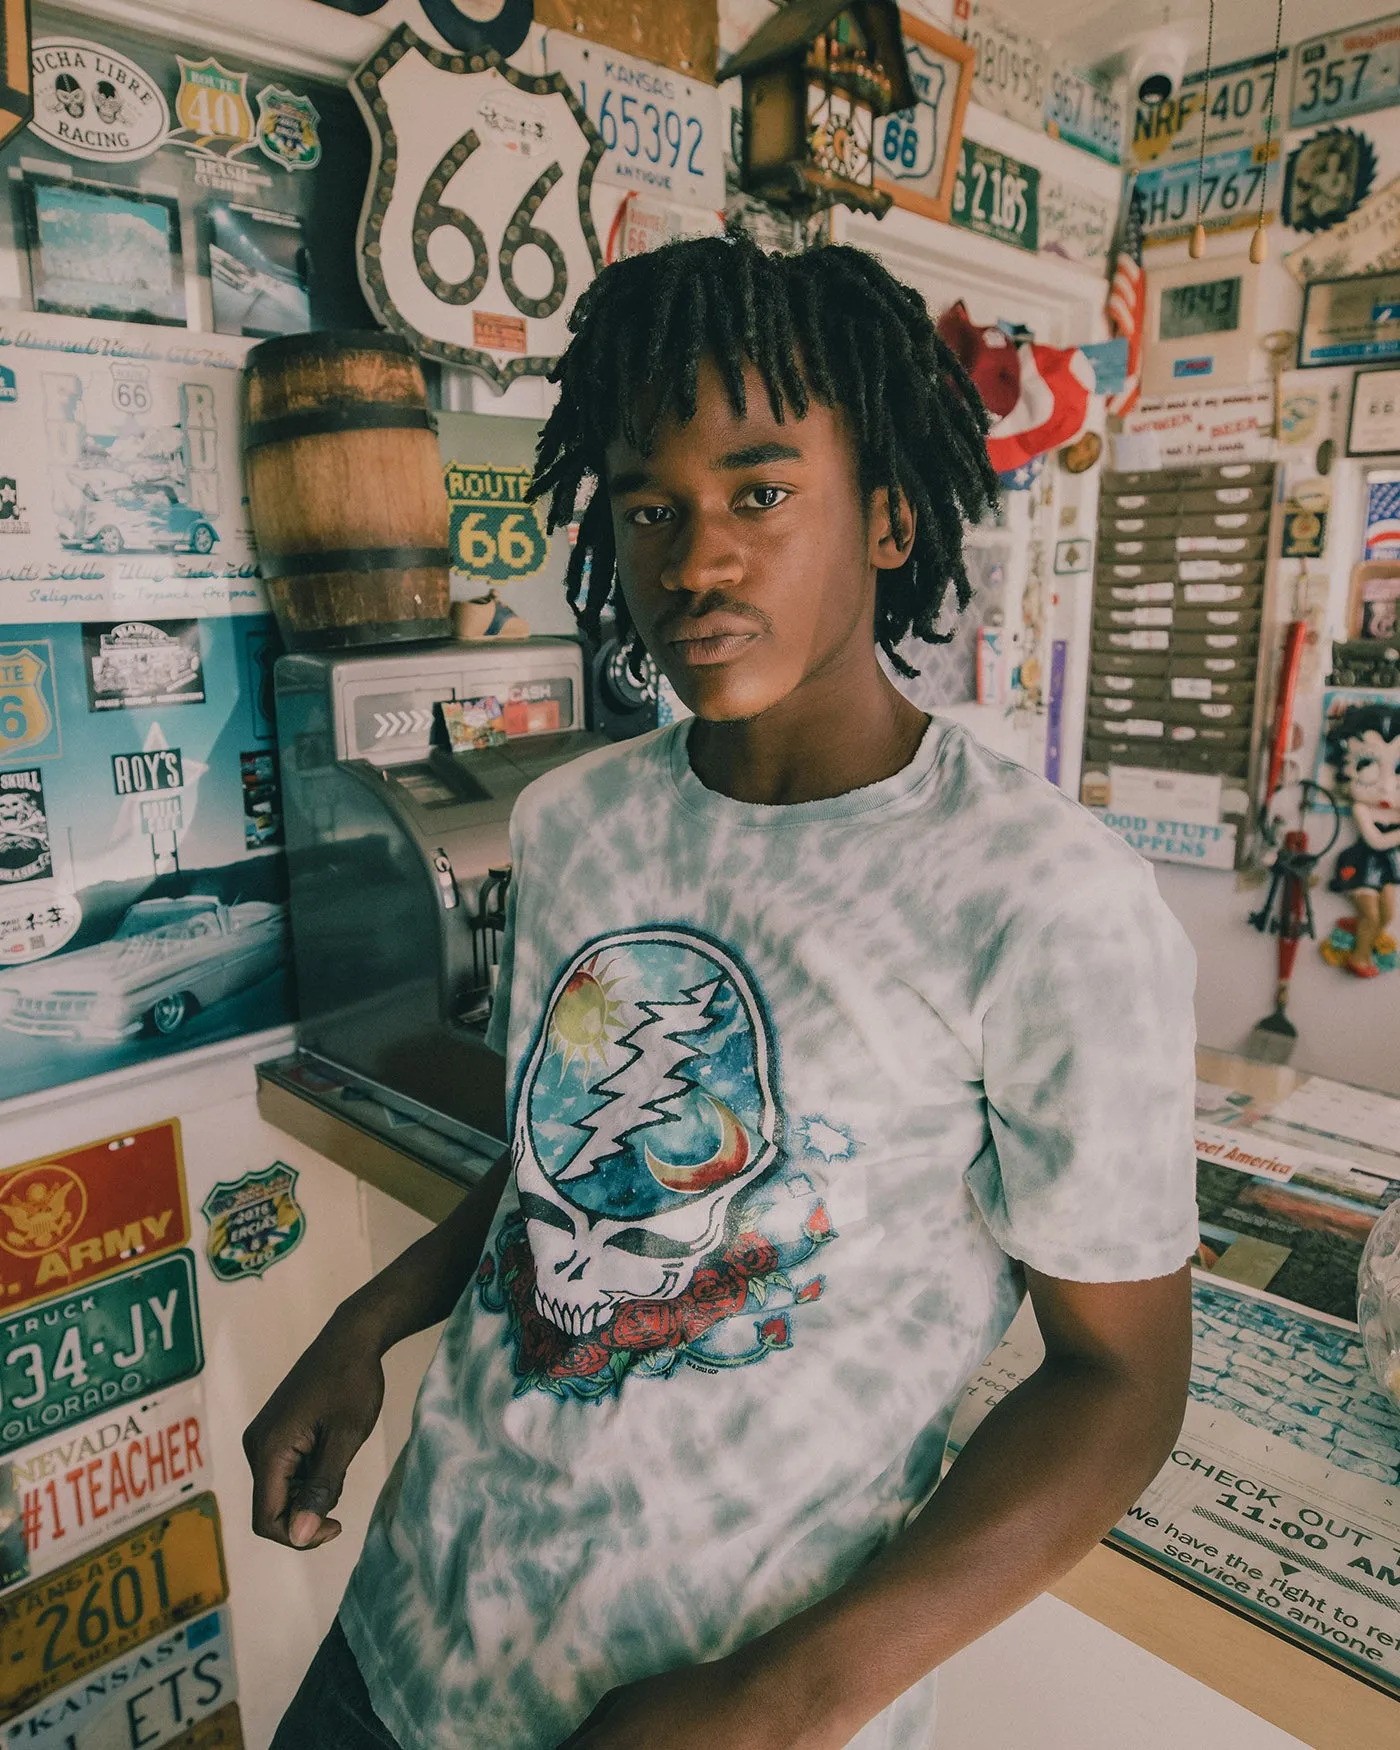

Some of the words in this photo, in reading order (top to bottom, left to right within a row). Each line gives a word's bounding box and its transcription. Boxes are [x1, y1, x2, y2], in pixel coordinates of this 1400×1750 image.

[32, 52, 86, 77] UCHA
[96, 58, 152, 106] LIBRE
[605, 61, 675, 100] KANSAS
[1300, 52, 1372, 112] 357
[58, 120, 130, 147] RACING
[188, 90, 240, 137] 40
[616, 163, 671, 189] ANTIQUE
[1201, 165, 1265, 214] 767
[412, 128, 567, 319] 66
[118, 384, 148, 408] 66
[449, 472, 532, 500] ROUTE
[458, 513, 535, 569] 66
[28, 589, 104, 607] Seligman
[114, 752, 181, 794] ROY'S
[1103, 813, 1148, 831] OOD
[1155, 821, 1223, 841] STUFF
[1123, 832, 1206, 857] APPENS
[1224, 1147, 1292, 1174] America
[34, 1210, 173, 1287] ARMY
[6, 1296, 97, 1339] TRUCK
[10, 1414, 144, 1490] NEVADA
[1171, 1450, 1282, 1508] CHECK
[1298, 1508, 1373, 1547] OUT
[1216, 1493, 1329, 1550] 11:00
[1127, 1506, 1160, 1528] We
[1163, 1521, 1219, 1558] have
[1225, 1552, 1264, 1581] the
[1269, 1577, 1327, 1613] right
[1333, 1607, 1359, 1628] to
[1163, 1542, 1251, 1594] service
[1256, 1588, 1281, 1608] to
[1286, 1606, 1384, 1662] anyone
[28, 1636, 175, 1738] KANSAS
